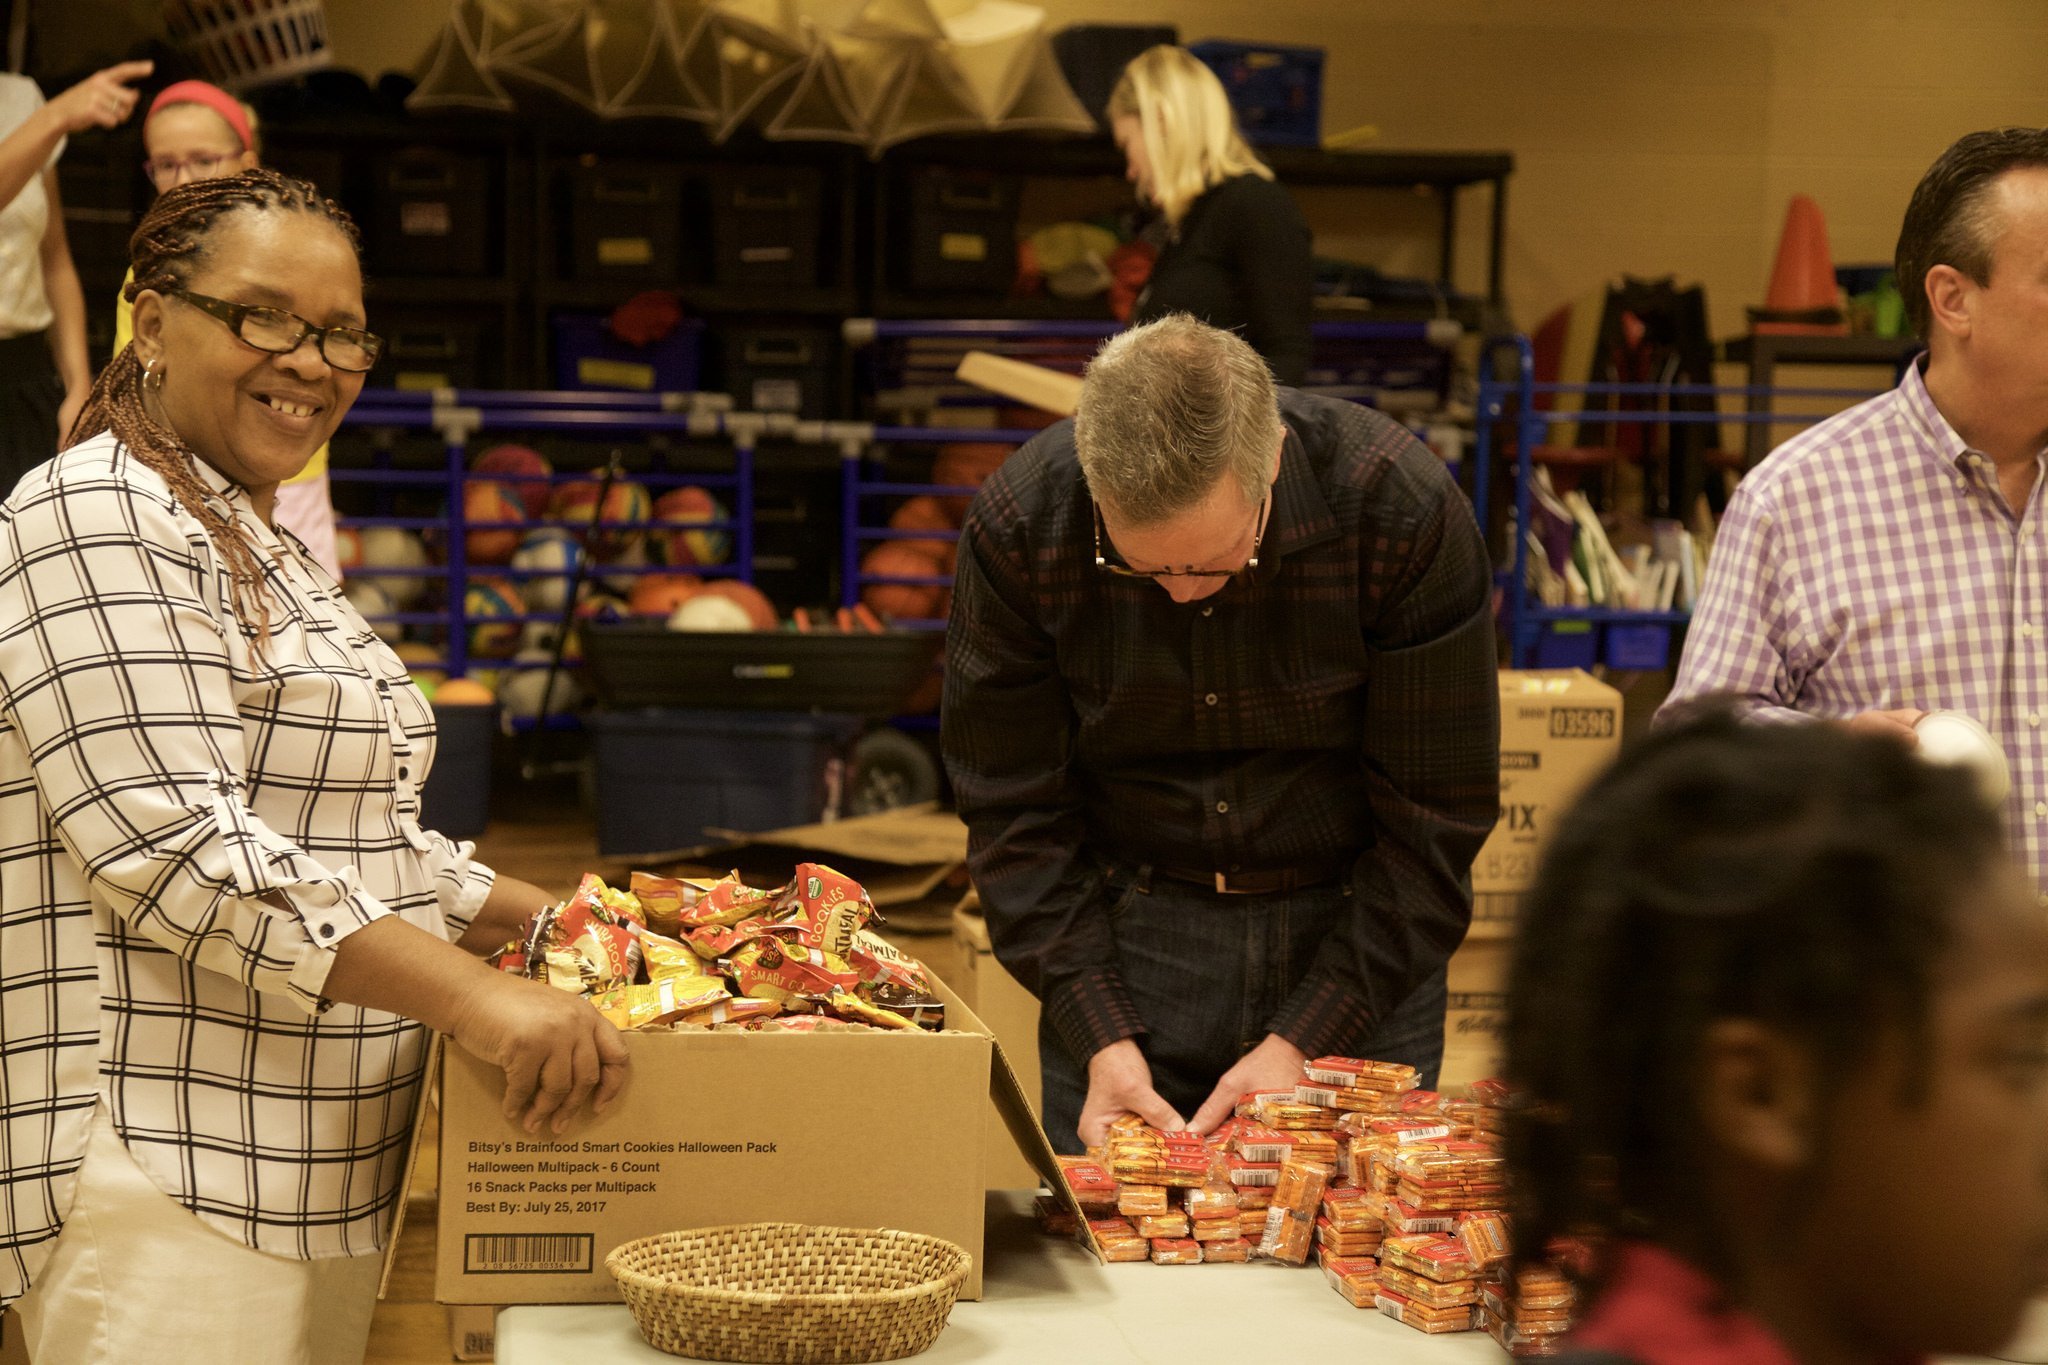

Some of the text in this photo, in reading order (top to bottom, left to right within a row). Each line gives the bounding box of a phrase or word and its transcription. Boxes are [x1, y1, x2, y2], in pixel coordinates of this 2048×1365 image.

[750, 969, 786, 987] SMART
[468, 1141, 777, 1156] Bitsy's Brainfood Smart Cookies Halloween Pack
[467, 1161, 535, 1173] Halloween
[537, 1161, 600, 1176] Multipack
[610, 1161, 619, 1173] 6
[621, 1161, 660, 1173] Count
[466, 1181, 657, 1196] 16 Snack Packs per Multipack
[466, 1201, 607, 1216] Best By: July 25, 2017
